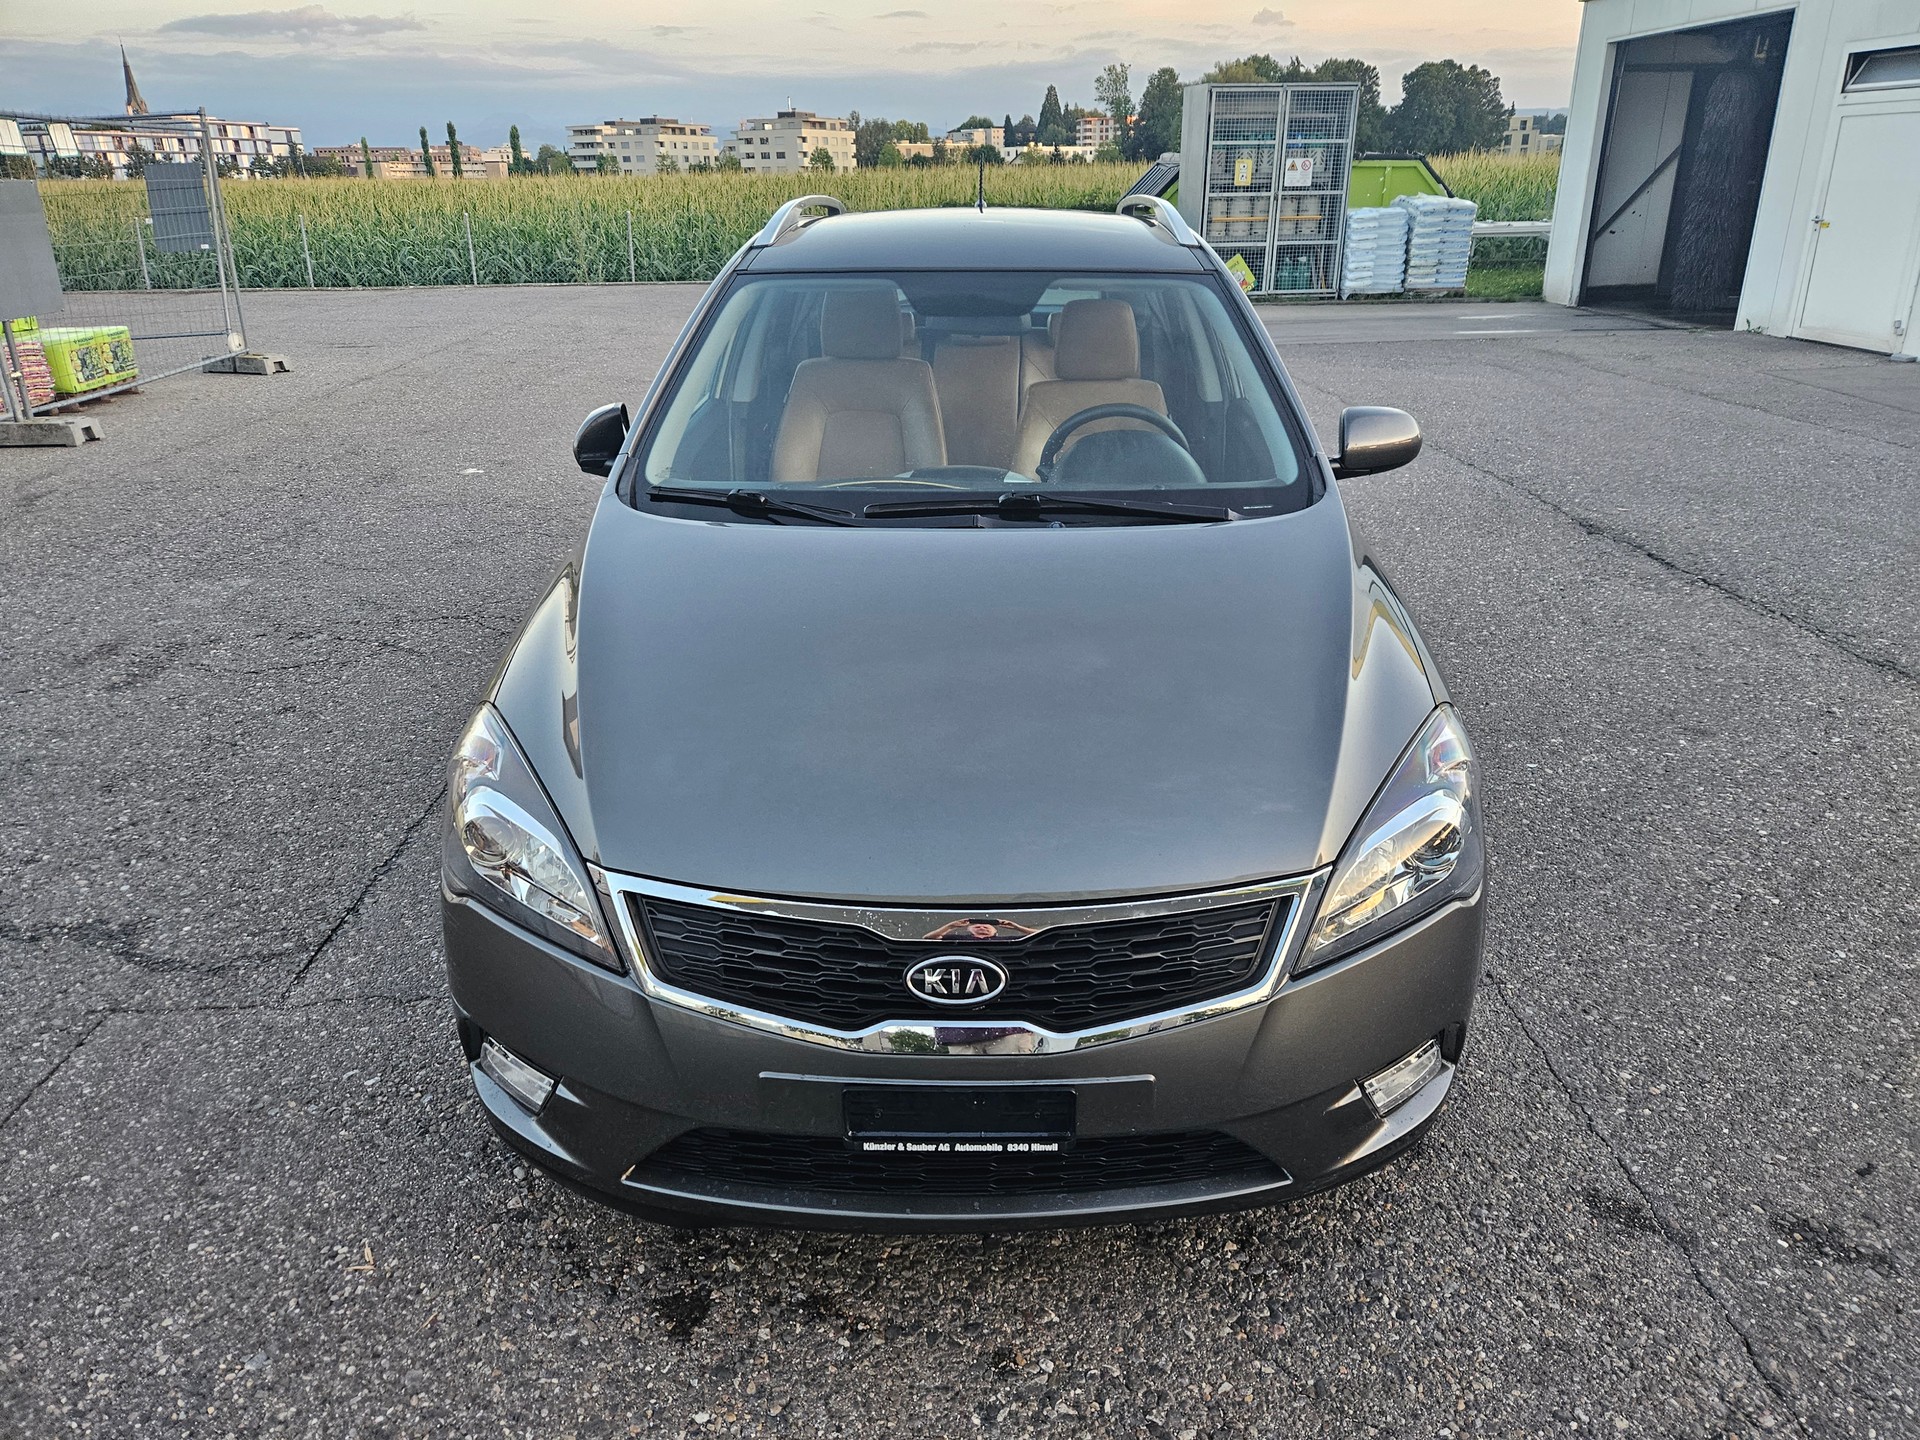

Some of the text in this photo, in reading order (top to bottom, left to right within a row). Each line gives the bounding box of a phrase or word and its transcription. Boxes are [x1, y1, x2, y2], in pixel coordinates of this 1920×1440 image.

[923, 968, 989, 994] KIA
[863, 1142, 1058, 1152] Künzler & Sauber AG Automobile 8340 Hinwil
